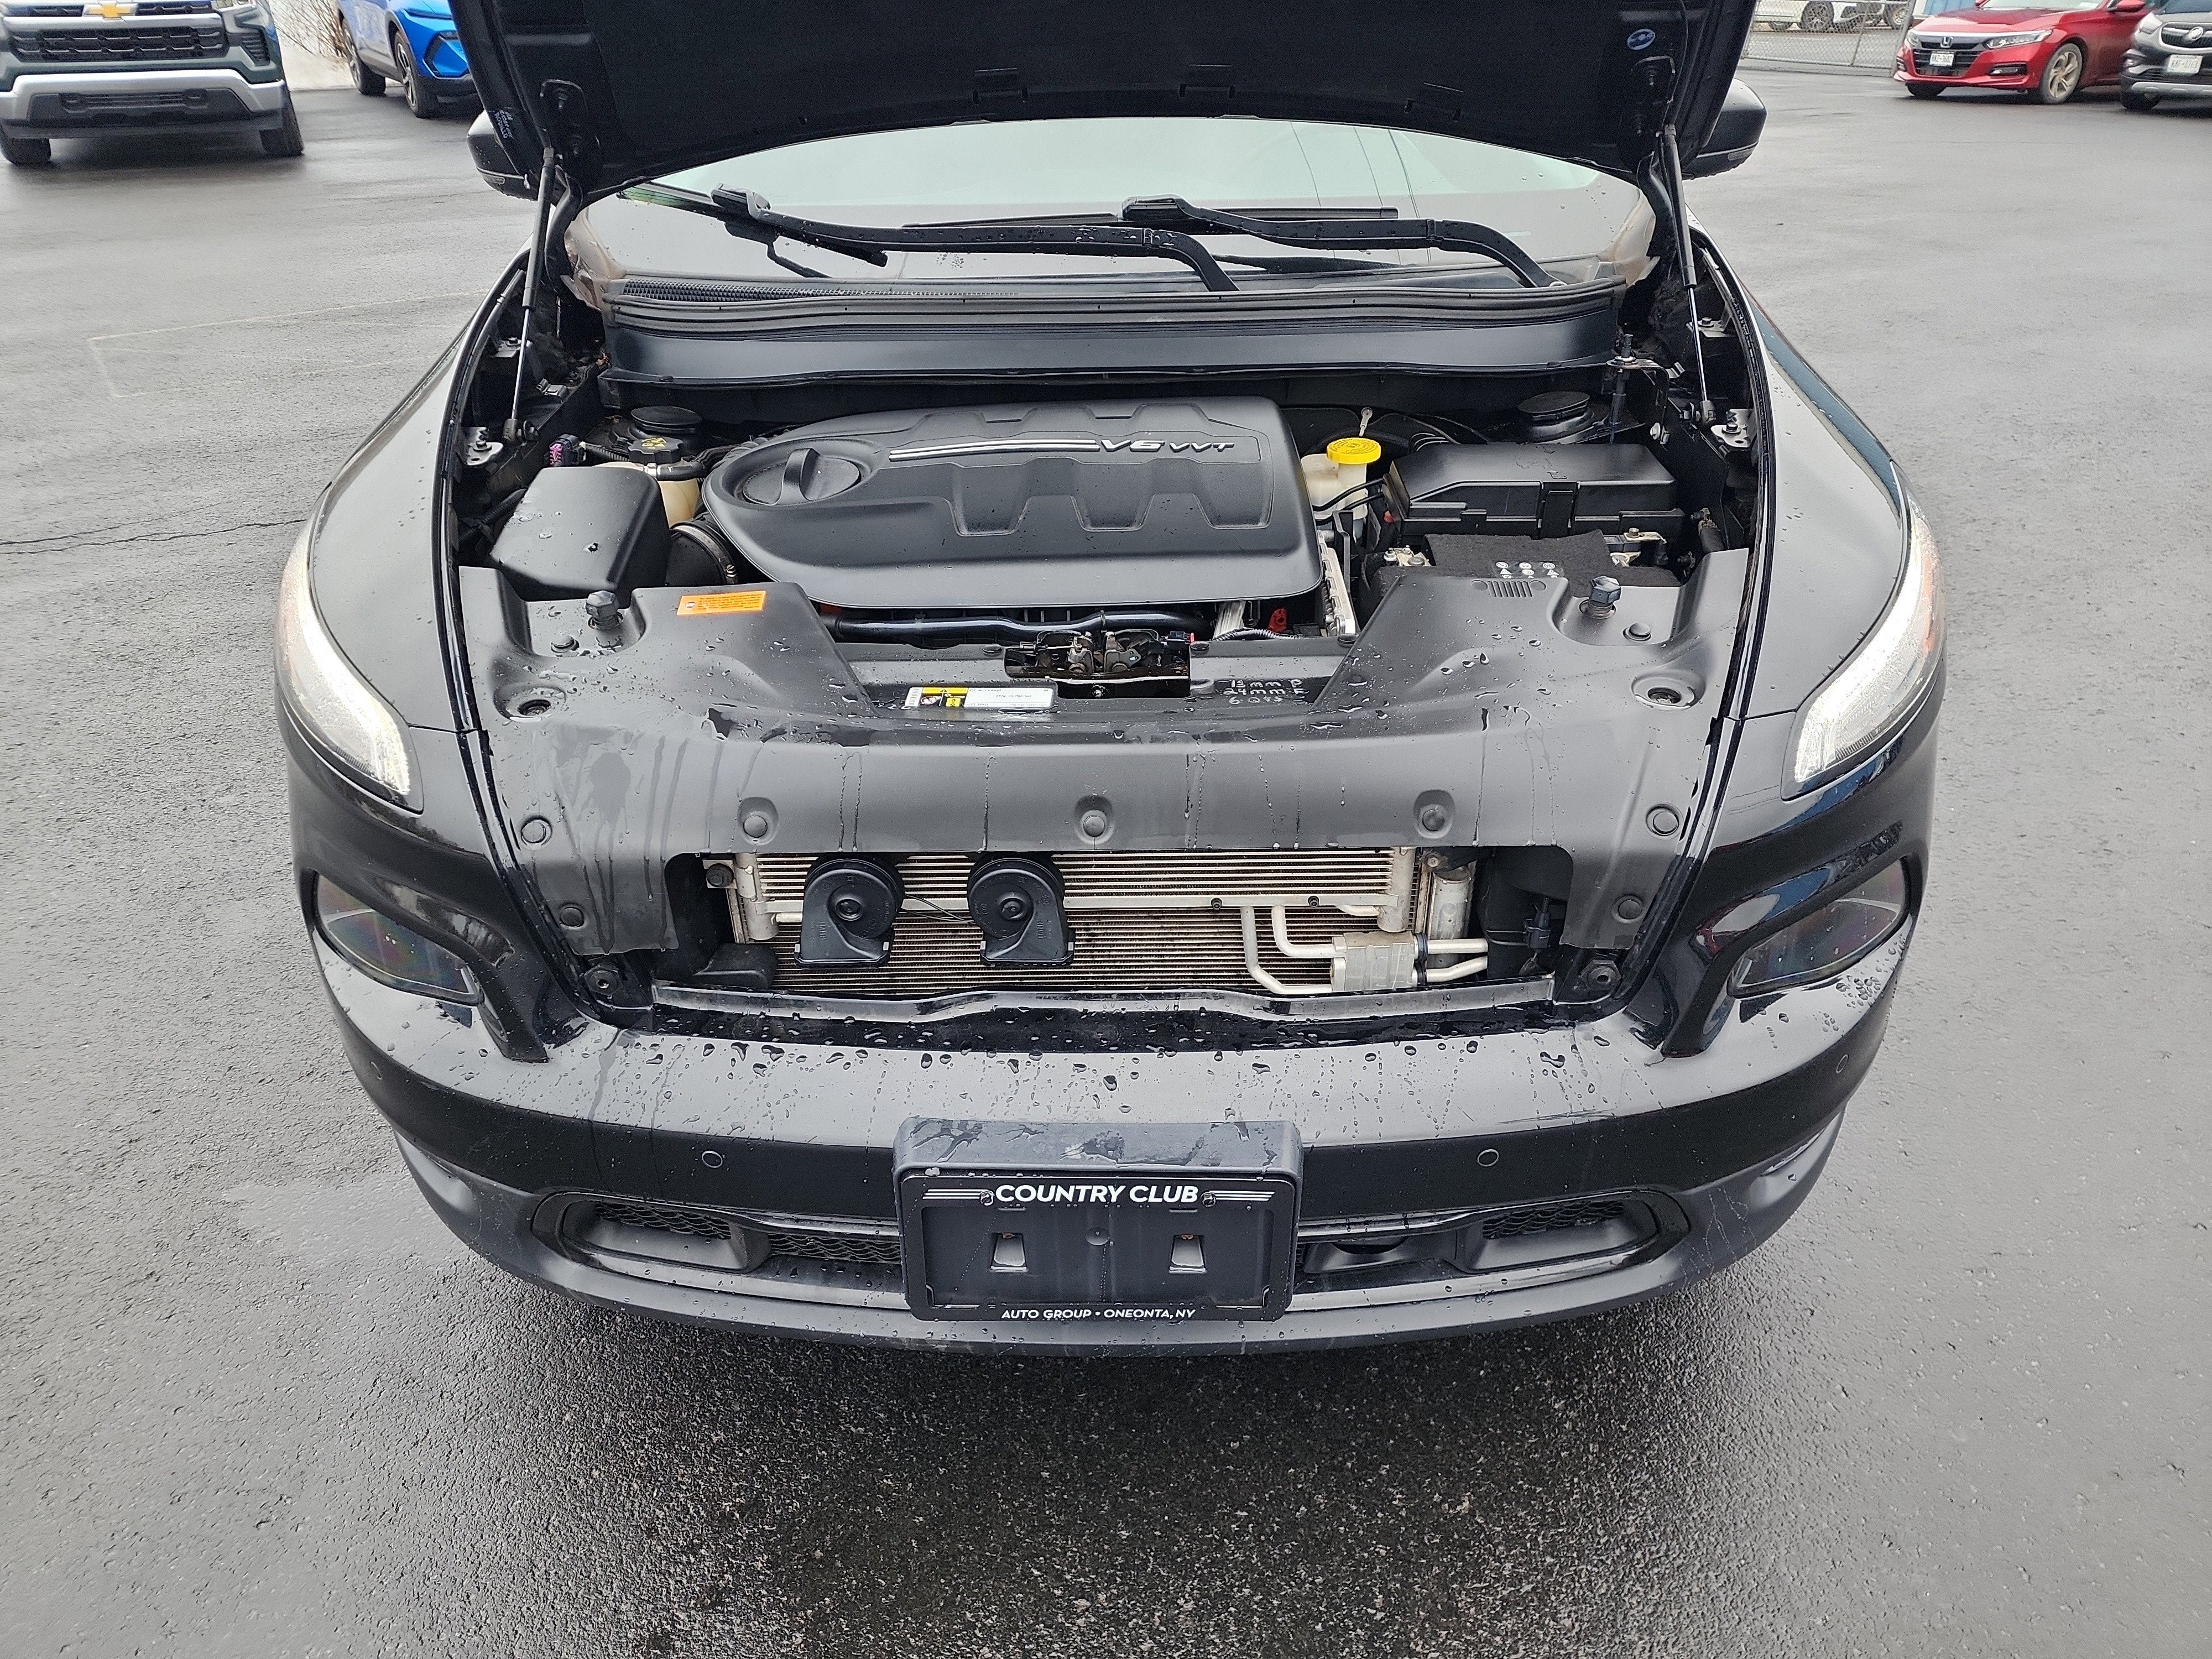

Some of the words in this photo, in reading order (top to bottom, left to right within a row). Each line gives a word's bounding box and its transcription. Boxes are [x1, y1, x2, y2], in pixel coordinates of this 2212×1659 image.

[1101, 440, 1166, 452] V6
[1169, 442, 1235, 453] VVT
[995, 1185, 1126, 1202] COUNTRY
[1129, 1185, 1199, 1203] CLUB
[1001, 1309, 1039, 1319] AUTO
[1043, 1309, 1092, 1319] GROUP
